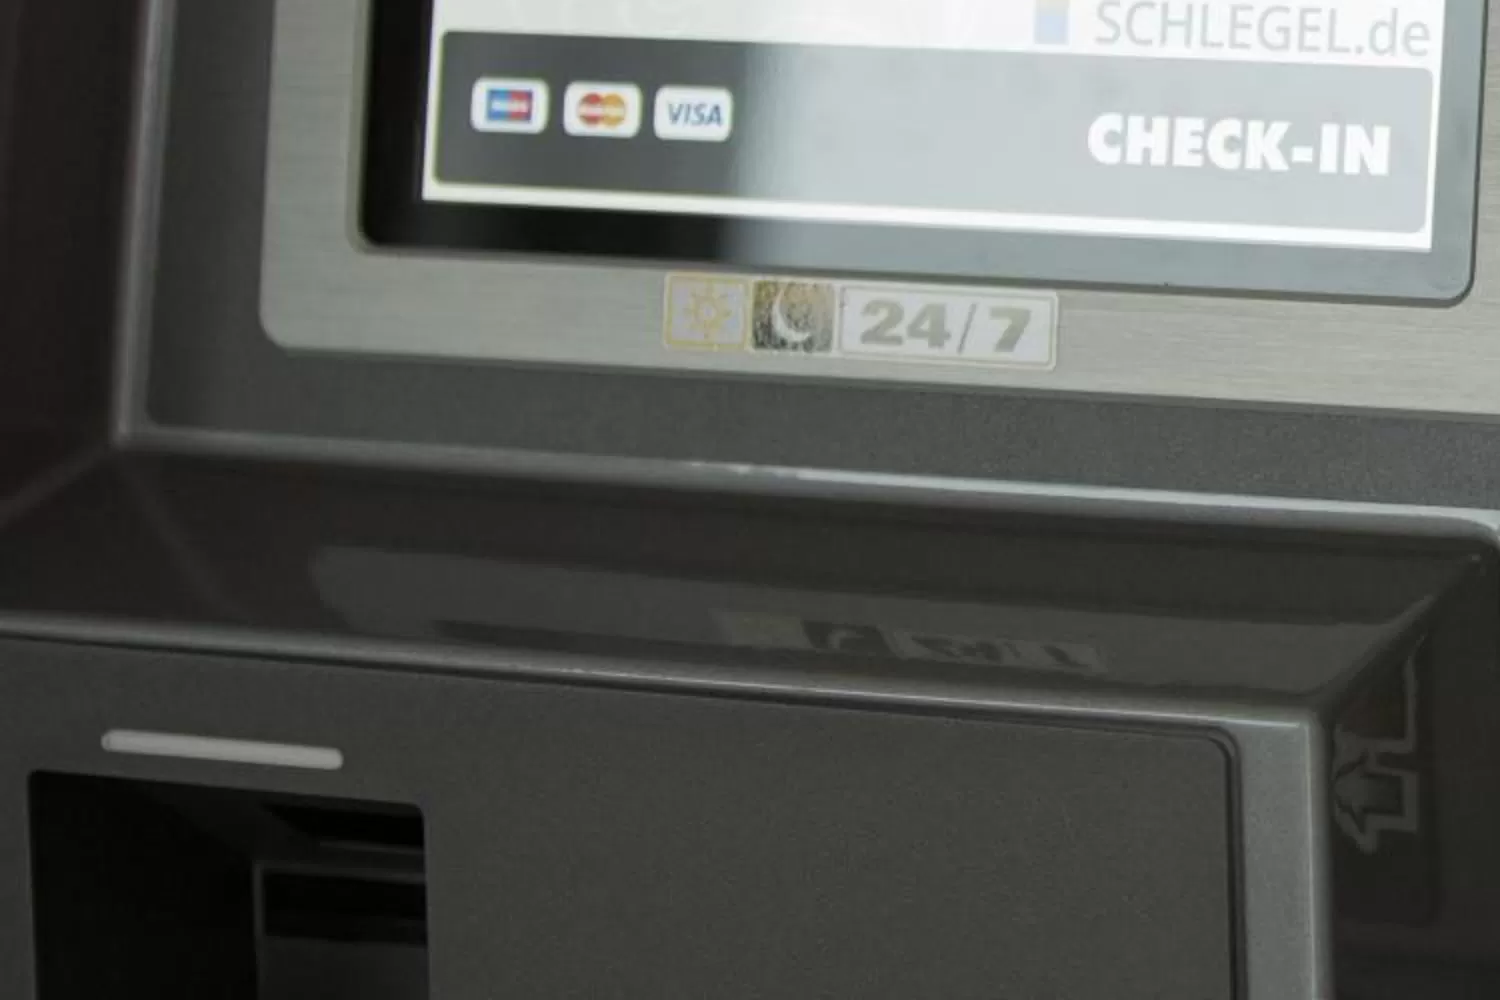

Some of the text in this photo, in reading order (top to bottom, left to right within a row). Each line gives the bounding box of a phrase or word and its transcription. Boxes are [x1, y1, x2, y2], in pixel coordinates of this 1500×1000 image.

[1095, 0, 1431, 56] SCHLEGEL.de
[668, 103, 723, 126] VISA
[1087, 112, 1392, 176] CHECK-IN
[859, 300, 1032, 354] 24/7
